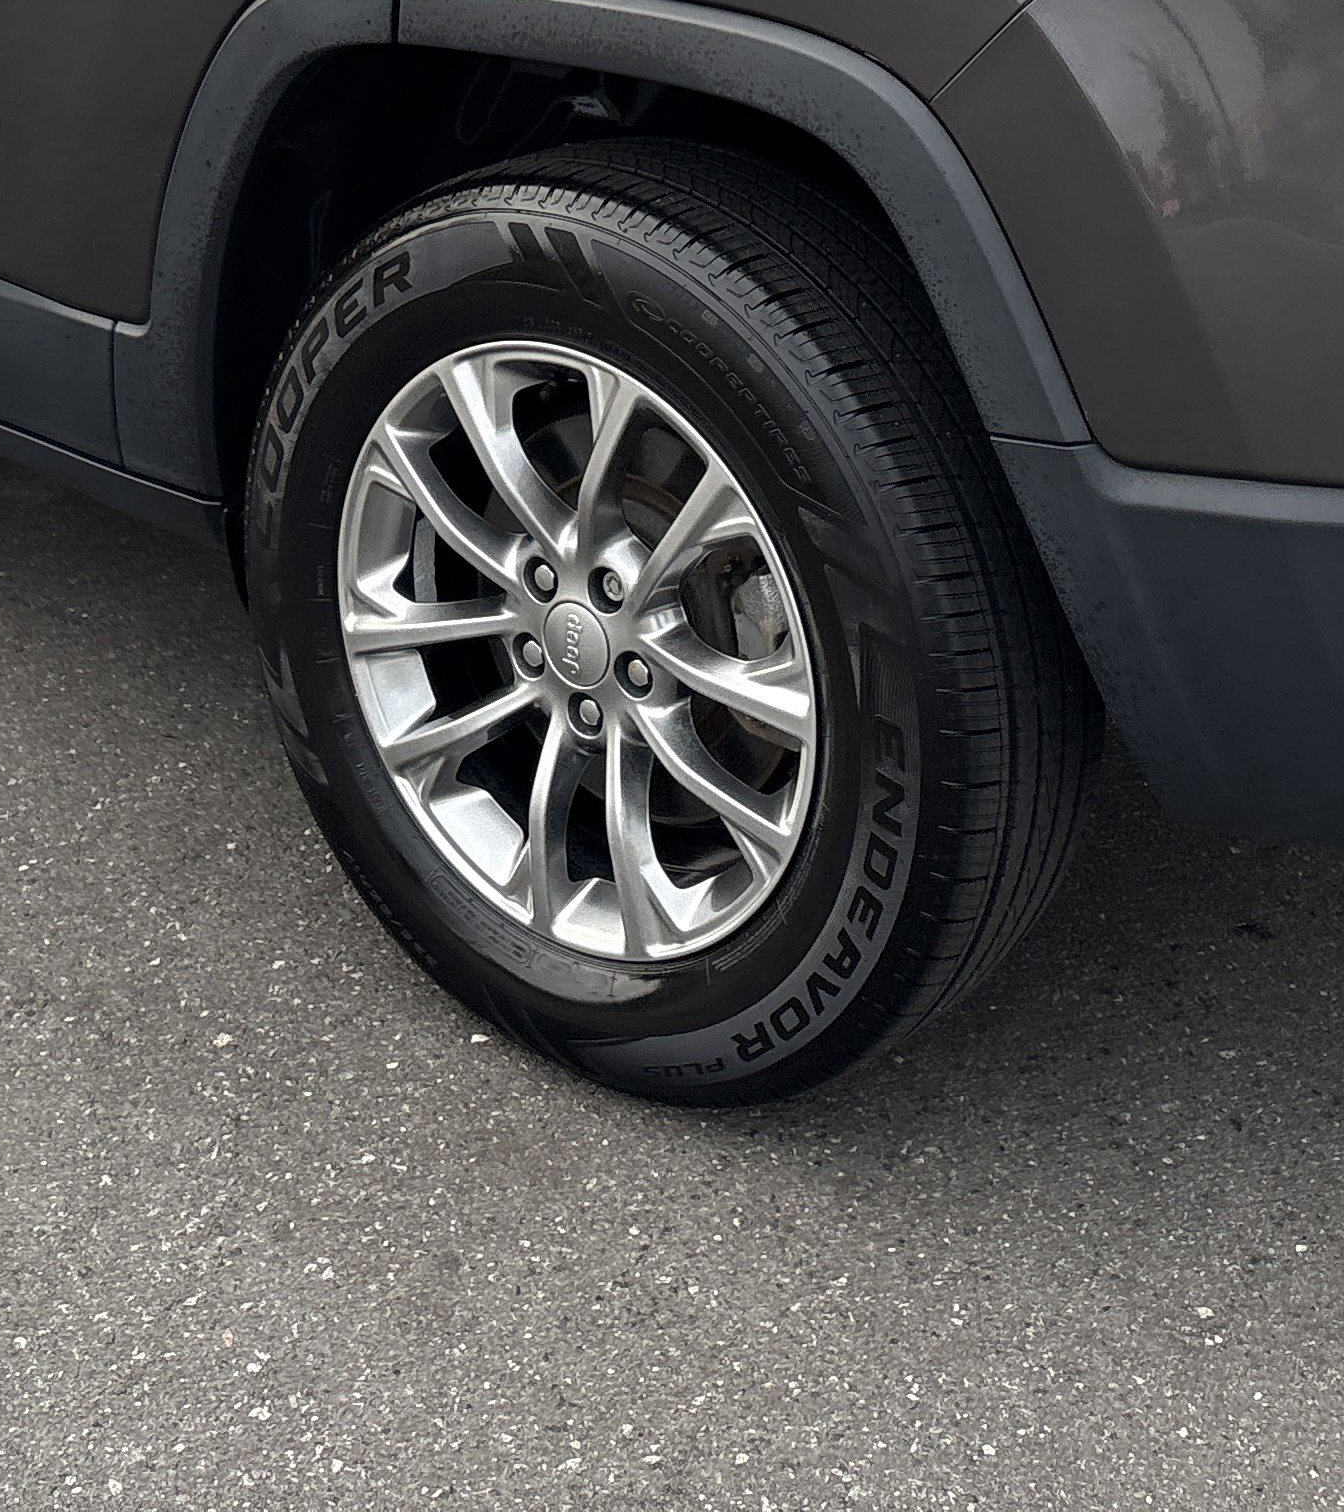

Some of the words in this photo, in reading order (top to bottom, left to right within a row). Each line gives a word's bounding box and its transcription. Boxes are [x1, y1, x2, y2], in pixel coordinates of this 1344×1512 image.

[665, 317, 755, 401] COOPER
[754, 403, 811, 484] TIRES
[562, 614, 582, 675] Jeep
[730, 713, 908, 1063] ENDEAVOR
[642, 1057, 725, 1078] PLUS
